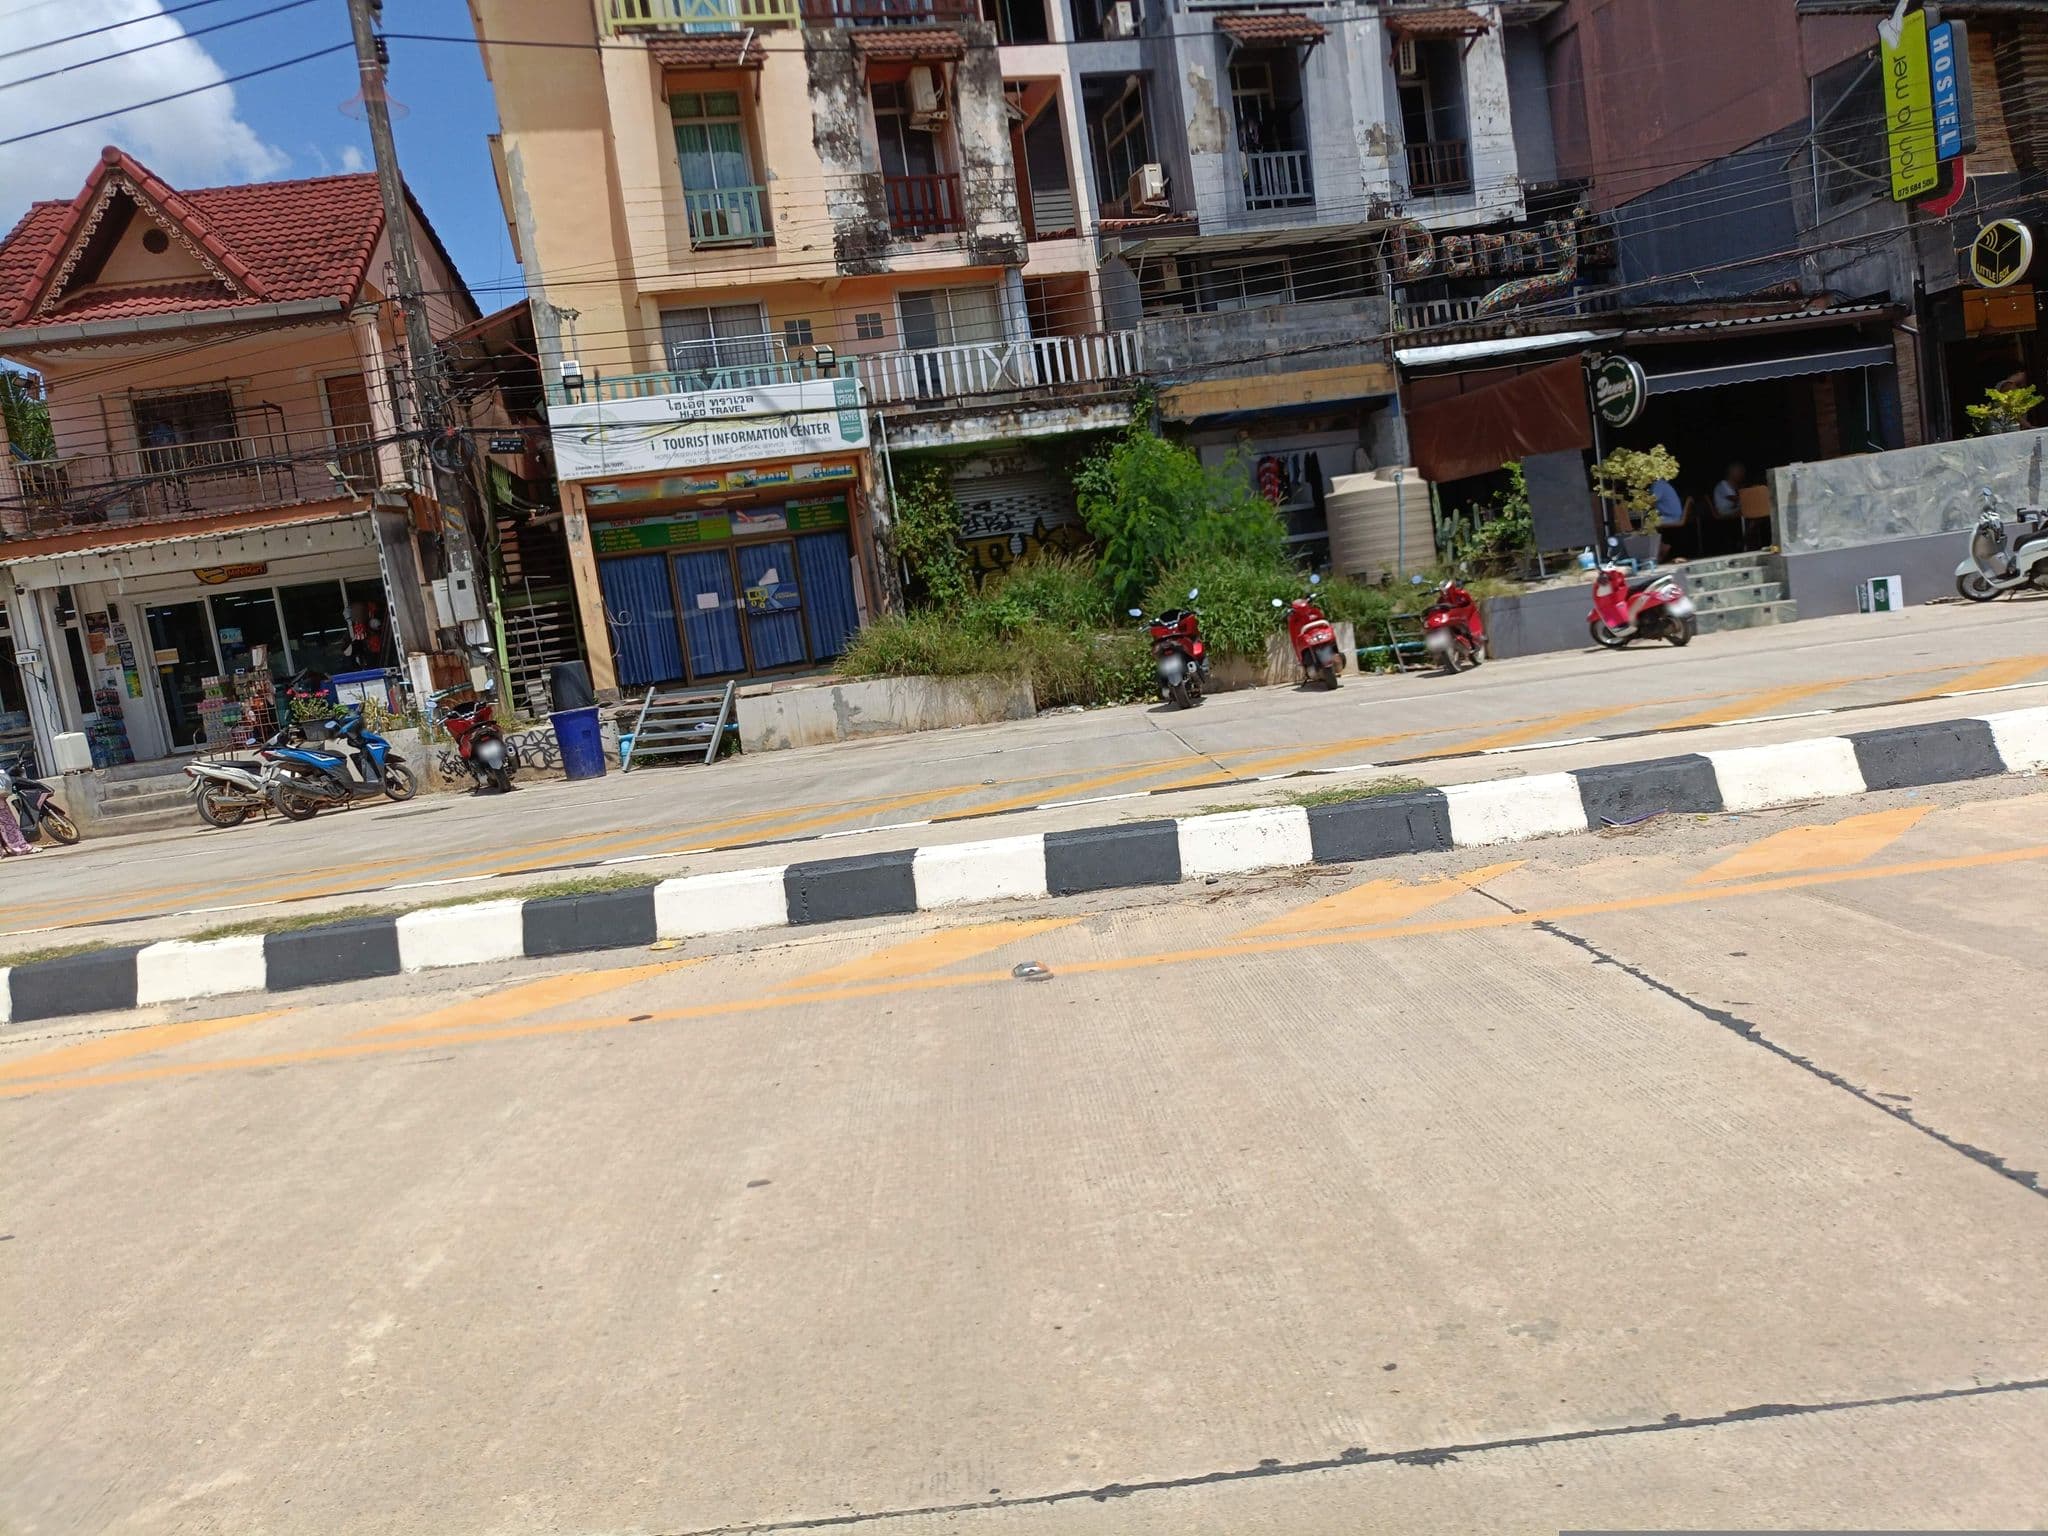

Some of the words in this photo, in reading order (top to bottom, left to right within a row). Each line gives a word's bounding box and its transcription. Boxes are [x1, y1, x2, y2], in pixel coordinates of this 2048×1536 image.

[1892, 55, 1910, 100] mer
[1932, 34, 1957, 147] HOSTEL
[1898, 136, 1915, 179] non
[1976, 263, 1997, 282] LITTLE
[1998, 264, 2010, 281] BOX
[709, 395, 754, 407] ทราเวล
[709, 404, 747, 416] TRAVEL
[662, 435, 709, 451] TOURIST
[711, 427, 789, 446] INFORMATION
[789, 422, 832, 437] CENTER
